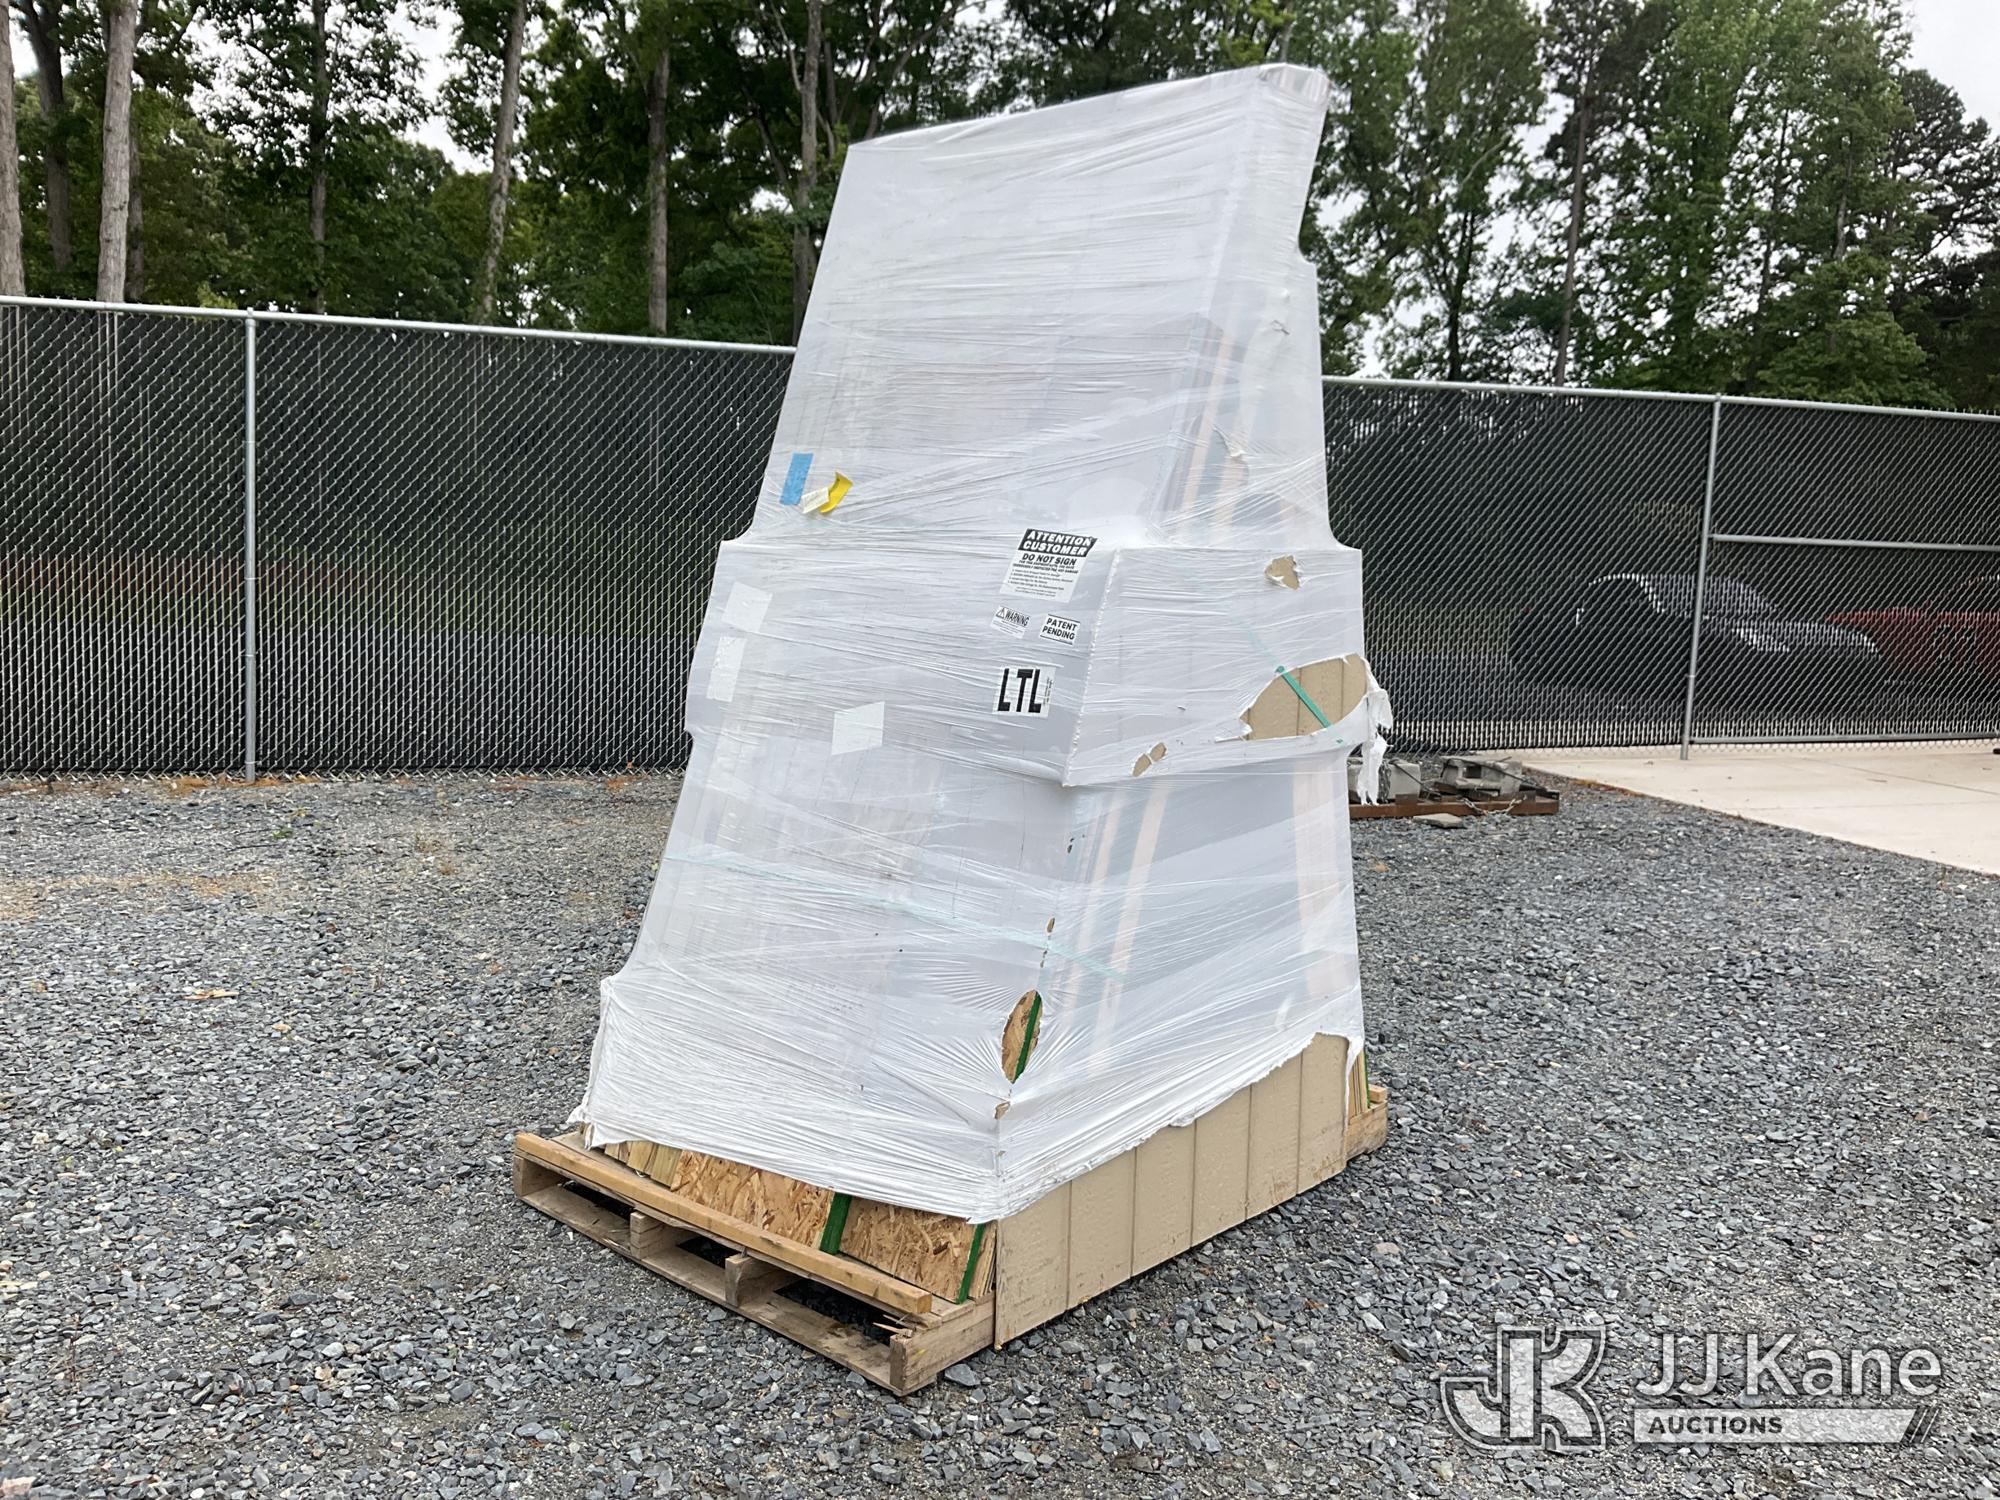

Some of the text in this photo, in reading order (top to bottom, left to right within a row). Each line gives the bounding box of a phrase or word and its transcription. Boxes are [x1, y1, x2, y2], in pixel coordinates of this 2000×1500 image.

[1027, 530, 1092, 546] ATTENTION
[1023, 541, 1087, 556] CUSTOMER
[1022, 553, 1035, 561] DO
[1036, 555, 1055, 563] NOT
[1055, 557, 1077, 566] SIGN
[1004, 609, 1030, 627] WARNING
[1046, 618, 1078, 631] PATENT
[1042, 626, 1075, 640] PENDING
[997, 668, 1042, 713] LTL
